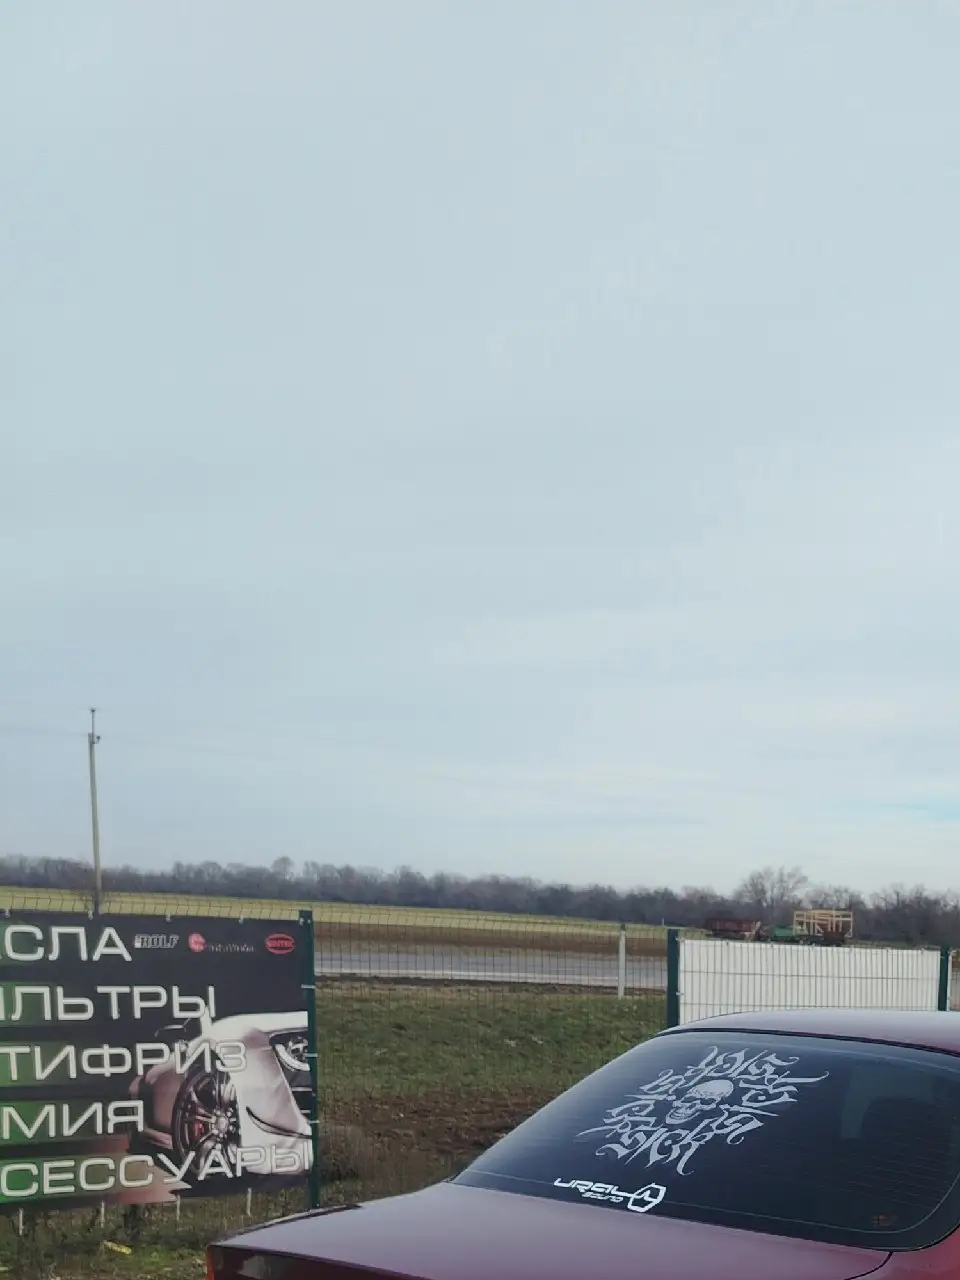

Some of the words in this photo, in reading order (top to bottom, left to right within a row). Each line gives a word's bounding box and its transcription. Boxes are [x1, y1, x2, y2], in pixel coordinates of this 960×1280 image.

[0, 924, 132, 962] СЛА
[0, 985, 216, 1021] ЛЬТРЫ
[0, 1040, 248, 1081] ТИФРИЗ
[2, 1100, 144, 1140] МИЯ
[0, 1139, 313, 1197] СЕССУАРЫ
